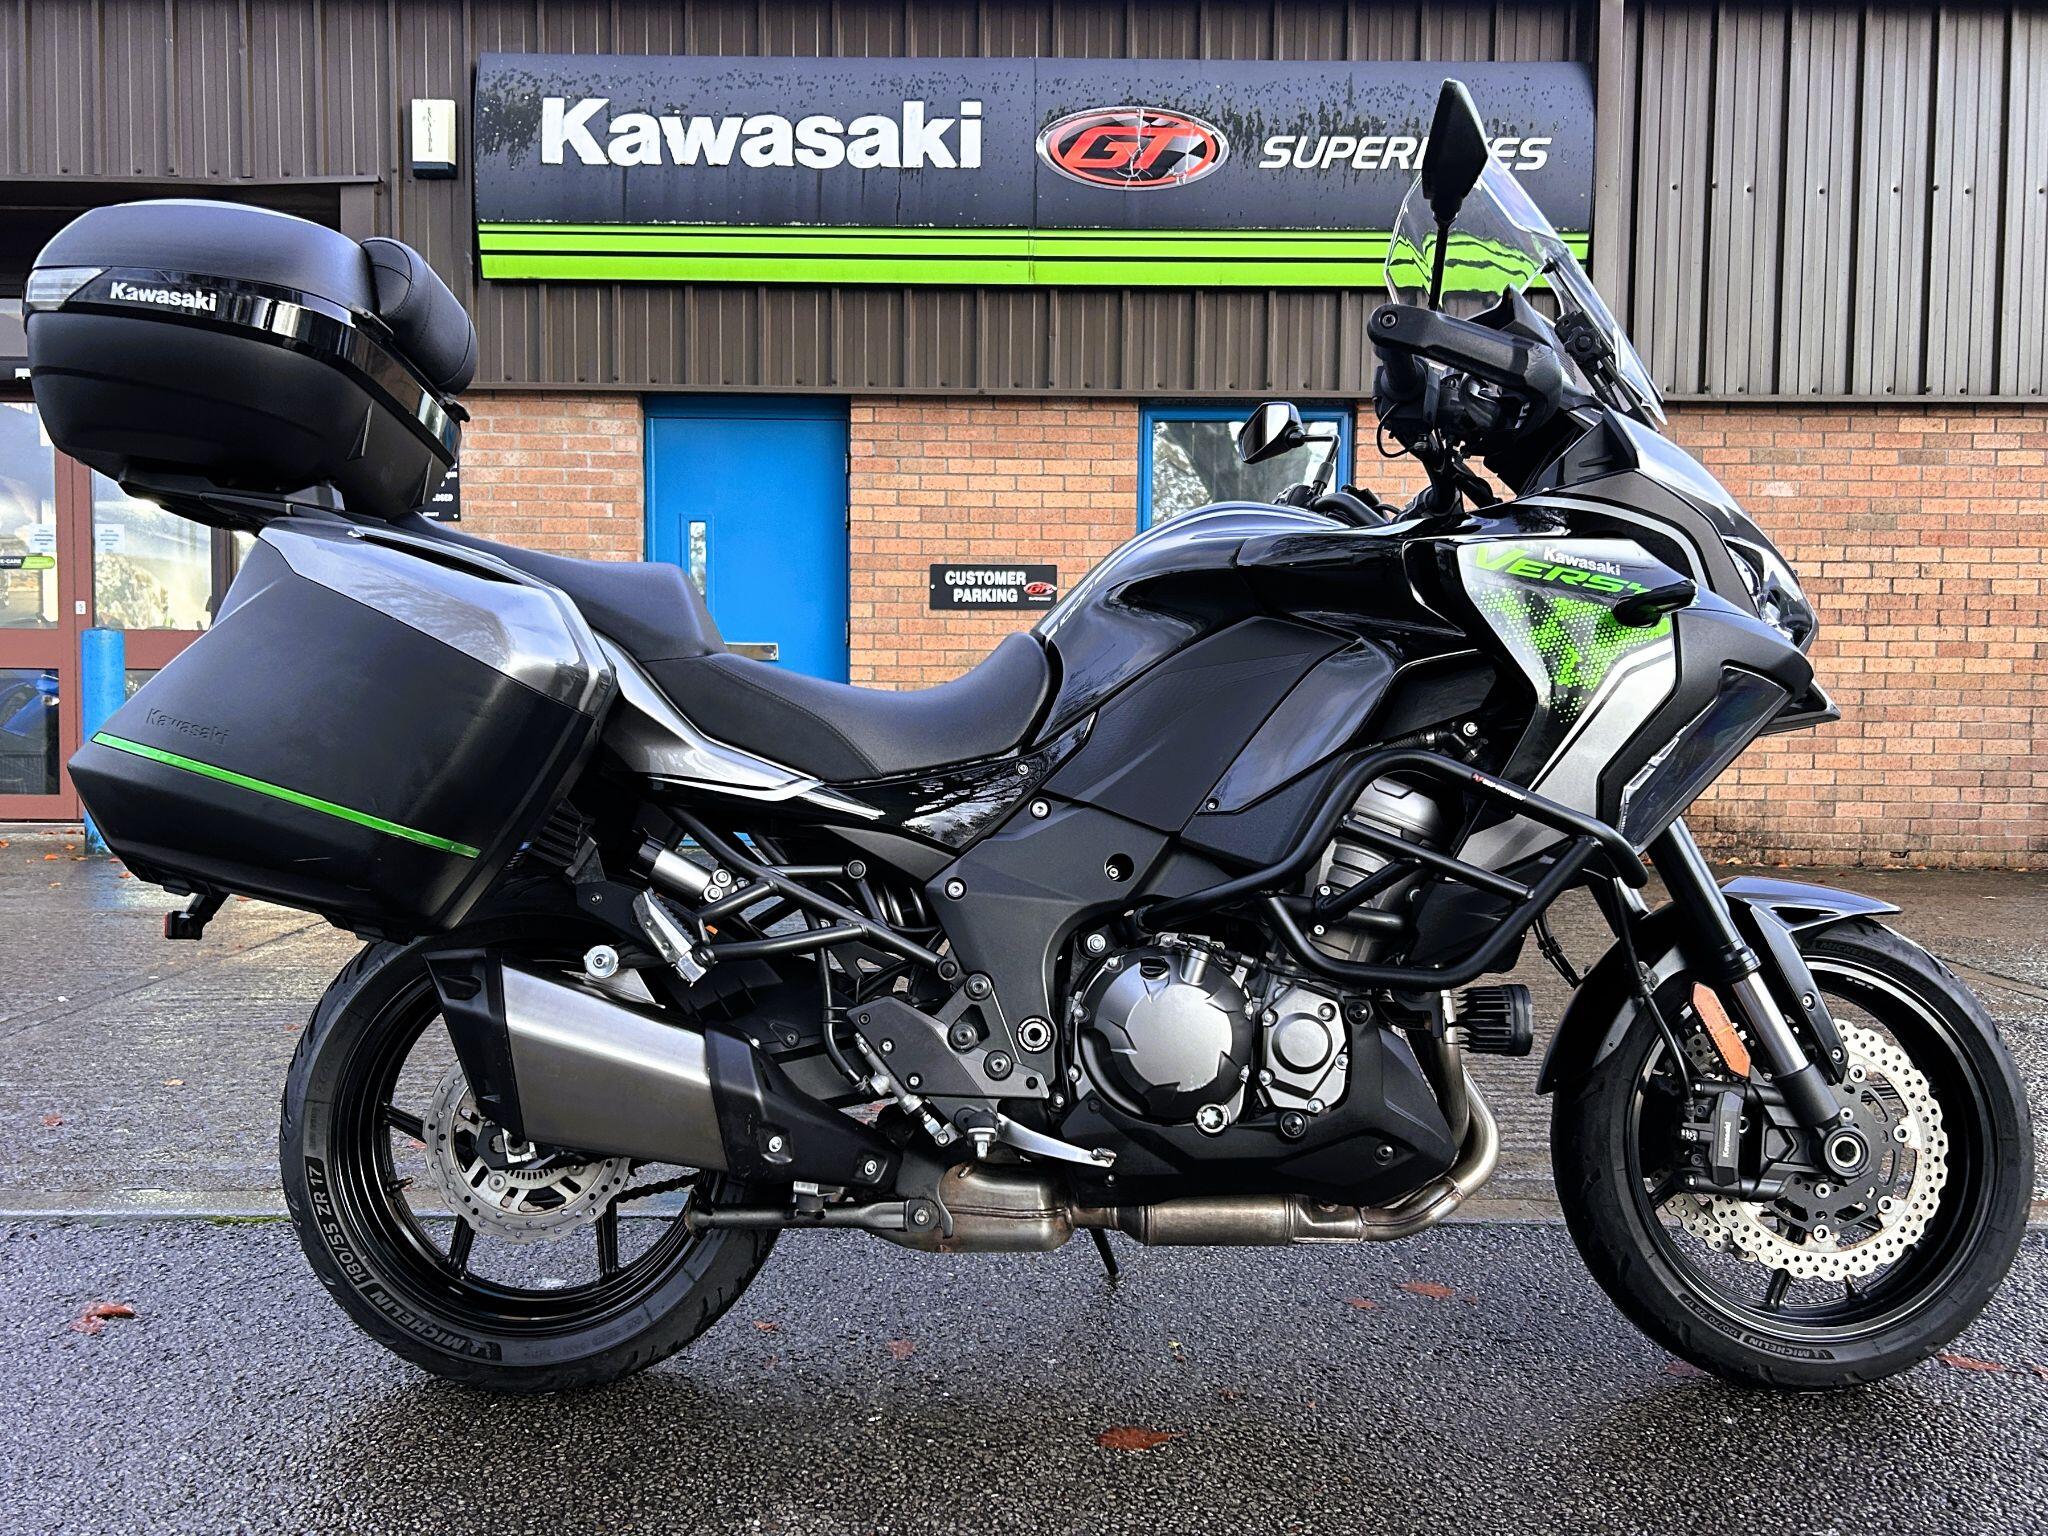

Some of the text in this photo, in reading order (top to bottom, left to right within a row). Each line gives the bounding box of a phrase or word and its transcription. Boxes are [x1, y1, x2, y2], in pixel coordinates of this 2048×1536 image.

[541, 97, 982, 169] Kawasaki
[1071, 126, 1552, 170] GT SUPERES
[109, 281, 218, 312] Kawasaki
[1543, 546, 1621, 576] Kawasaki
[944, 570, 1027, 586] CUSTOMER
[953, 588, 1018, 603] PARKING
[145, 707, 230, 745] Kawasaki
[308, 1164, 325, 1188] 17
[313, 1192, 333, 1217] ZR
[323, 1222, 368, 1285] 180/55
[369, 1289, 466, 1352] MICHELIN
[1684, 1298, 1739, 1337] 120/70 ZR 17
[1748, 1338, 1810, 1358] MICHELIN
